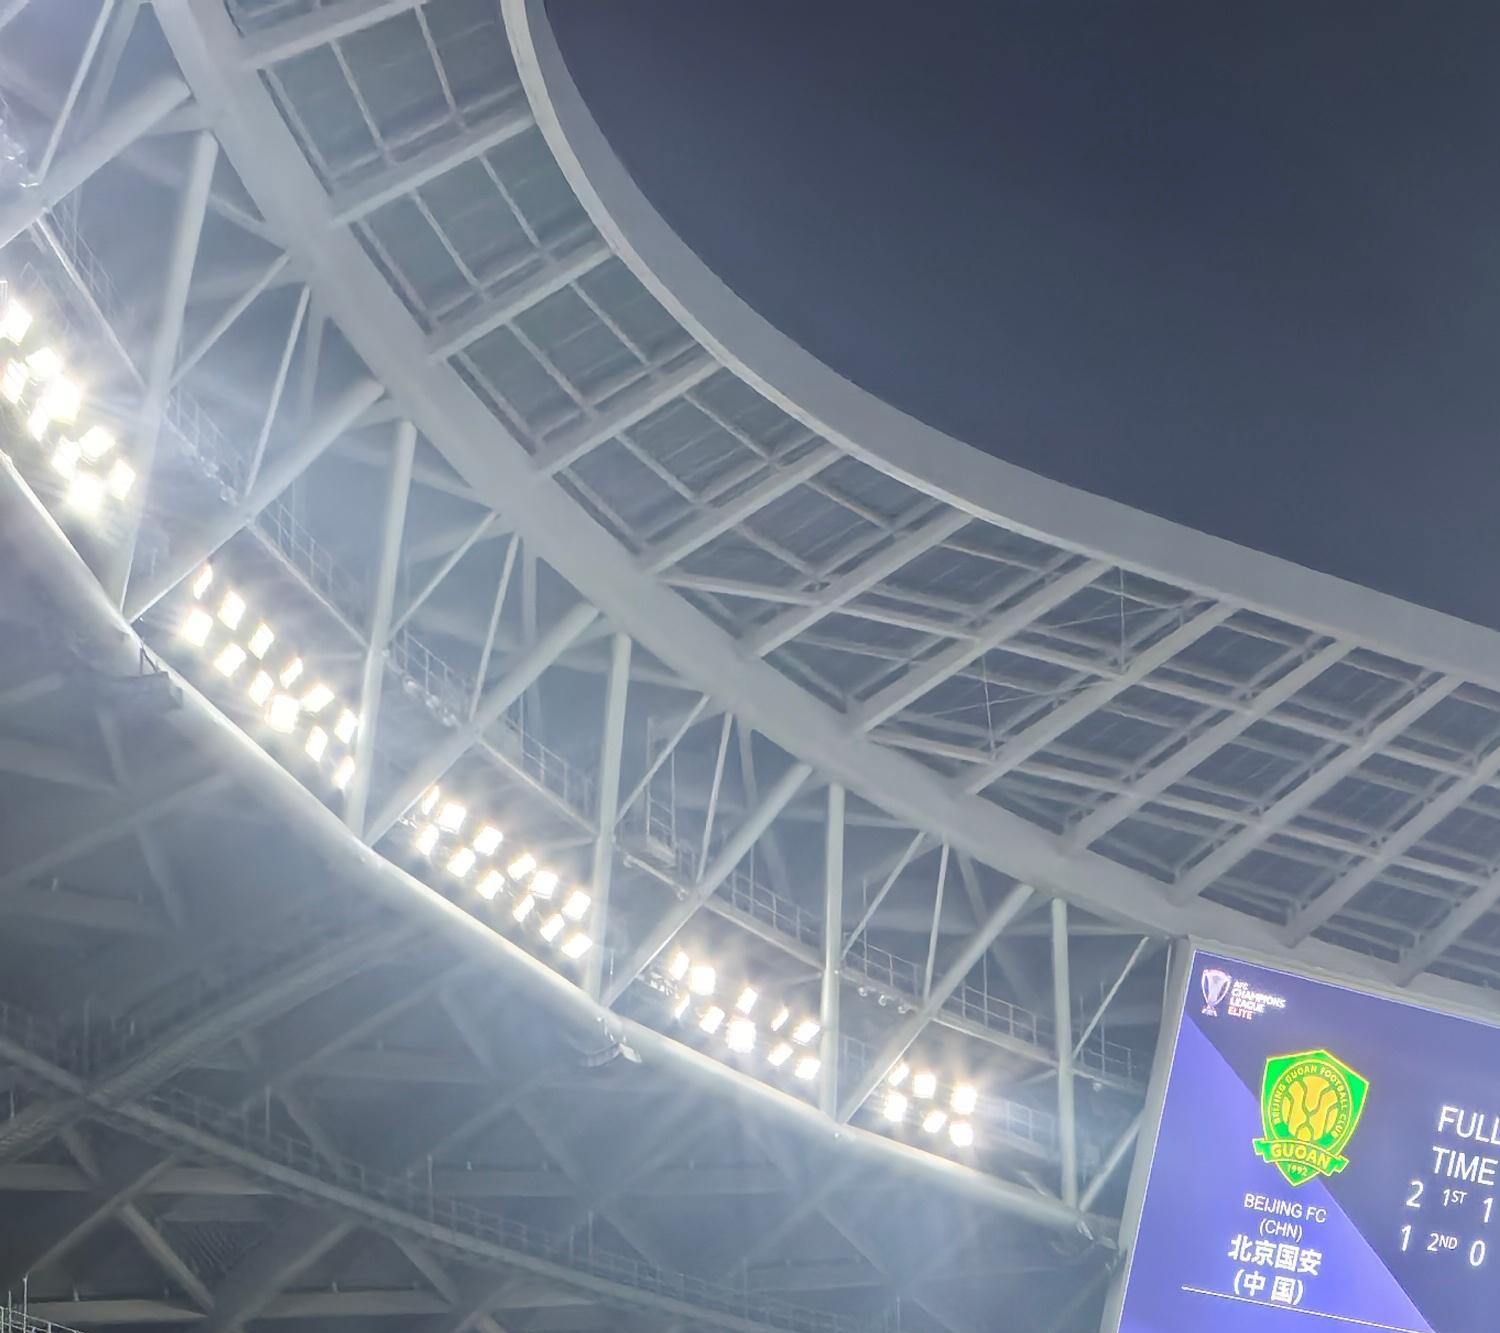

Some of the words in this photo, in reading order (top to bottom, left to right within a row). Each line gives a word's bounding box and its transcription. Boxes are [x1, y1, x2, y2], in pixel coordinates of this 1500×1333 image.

[1227, 1005, 1252, 1020] ELITE
[1229, 997, 1265, 1013] LEAGUE
[1231, 988, 1286, 1008] CHAMPIONS
[1271, 1143, 1332, 1171] GUOAN
[1432, 1146, 1499, 1186] TIME
[1243, 1193, 1303, 1219] BEIJING
[1305, 1206, 1327, 1223] FC
[1406, 1180, 1424, 1208] 2
[1442, 1188, 1468, 1207] 1ST
[1482, 1197, 1494, 1223] 1
[1259, 1218, 1303, 1243] (CHN)
[1227, 1234, 1322, 1276] 北京国安
[1401, 1225, 1412, 1252] 1
[1426, 1232, 1458, 1252] 2ND
[1469, 1240, 1486, 1267] 0
